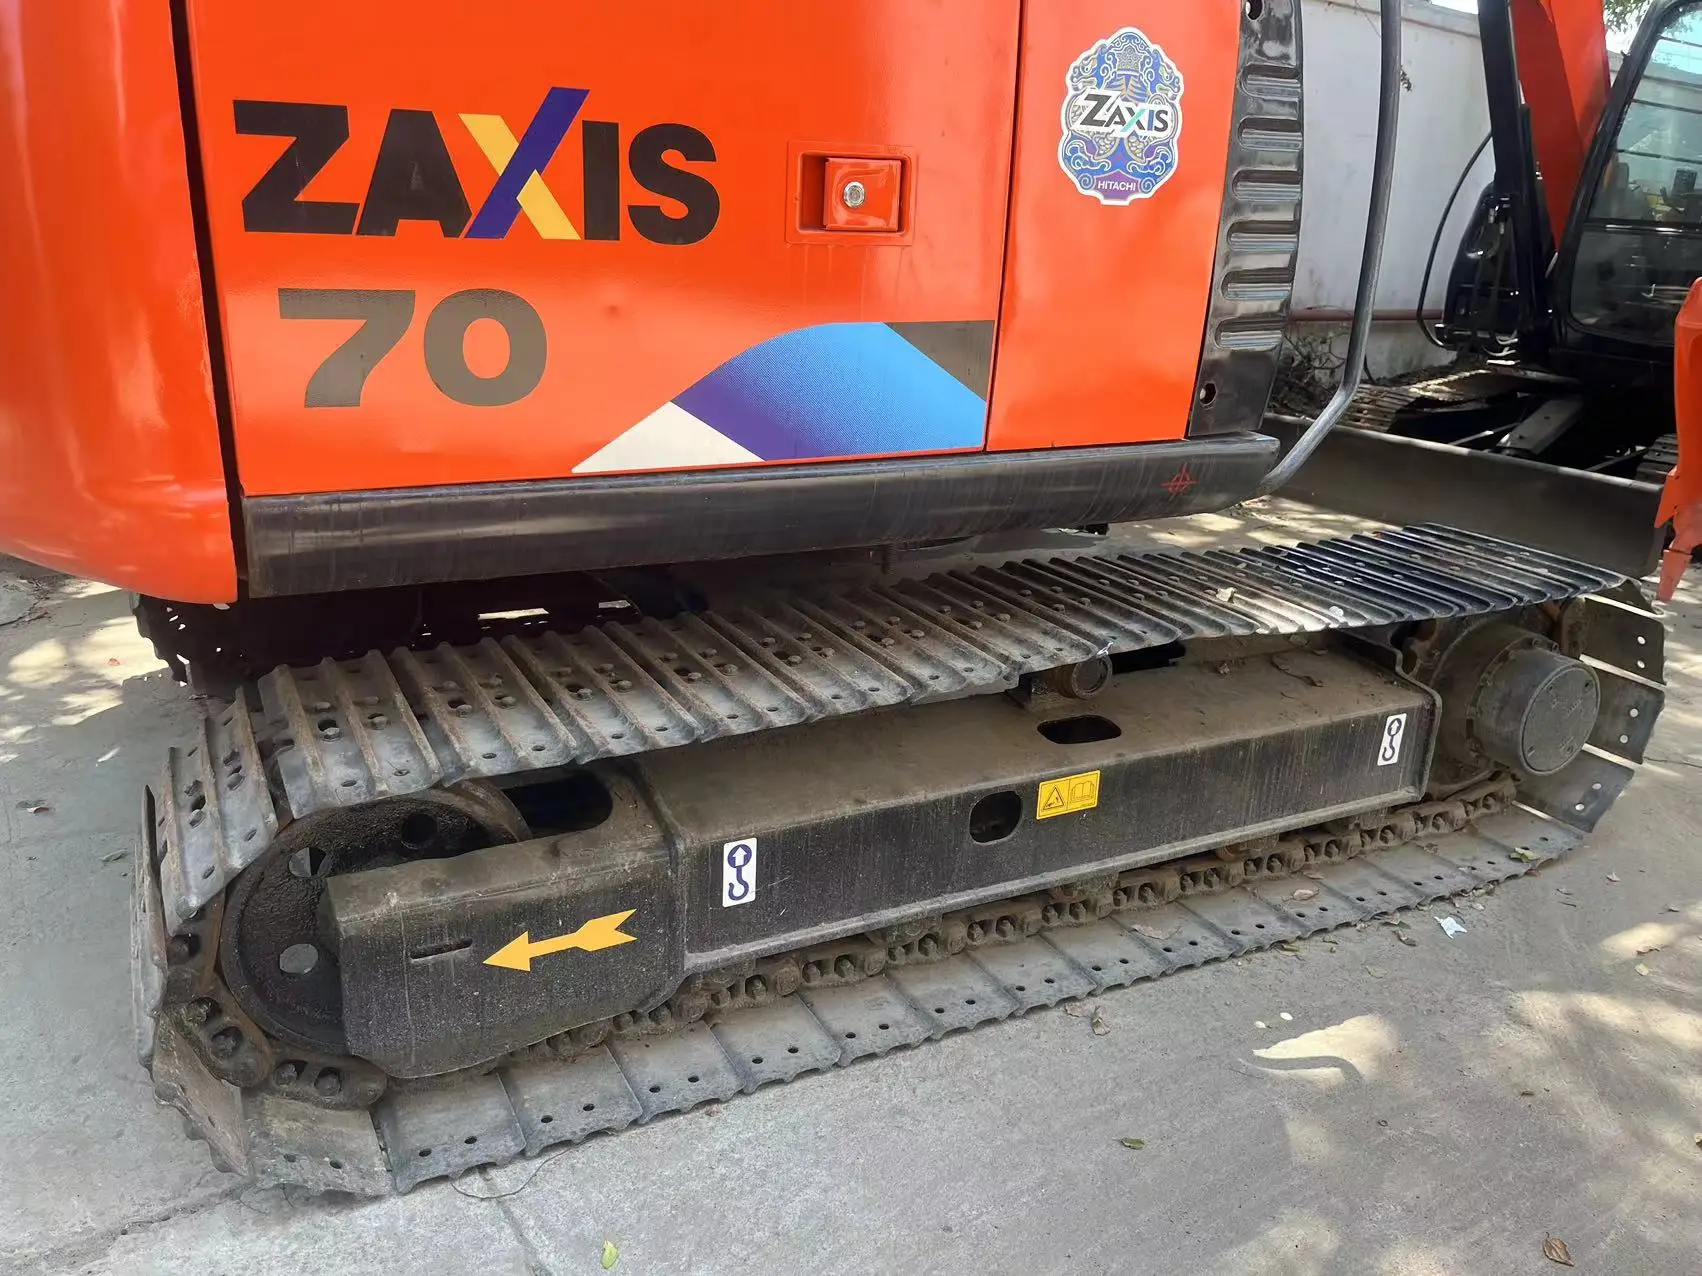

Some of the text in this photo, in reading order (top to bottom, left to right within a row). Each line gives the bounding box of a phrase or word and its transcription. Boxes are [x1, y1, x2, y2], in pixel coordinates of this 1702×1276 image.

[1080, 94, 1168, 133] ZAXIS
[233, 87, 720, 245] ZAXIS
[1098, 180, 1136, 191] HITACHI
[278, 288, 547, 408] 70
